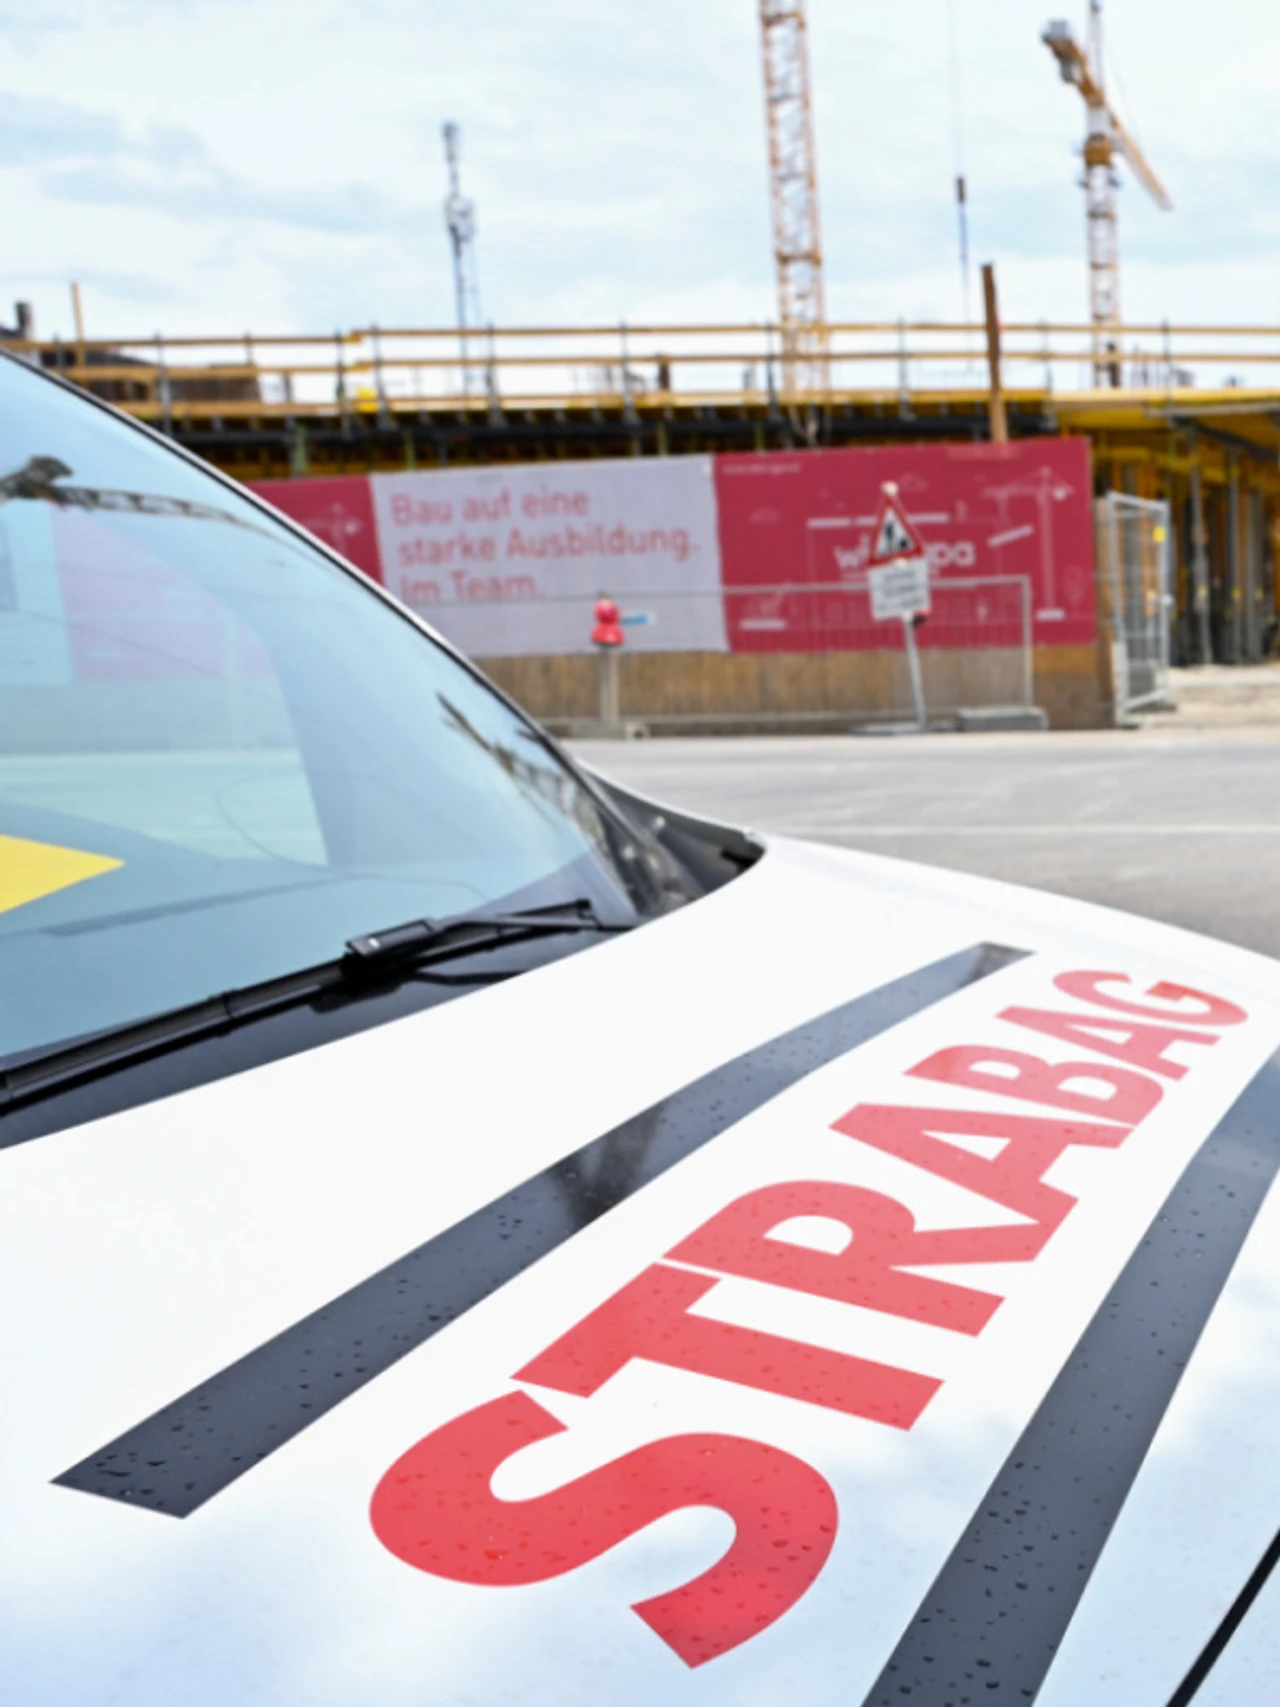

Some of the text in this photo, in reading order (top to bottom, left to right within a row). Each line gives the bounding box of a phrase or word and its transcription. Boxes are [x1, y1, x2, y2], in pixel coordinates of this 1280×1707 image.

[390, 483, 590, 526] Bau auf eine
[397, 520, 701, 567] starke Ausbildung.
[447, 569, 546, 600] Team.
[369, 970, 1249, 1669] STRABAG
